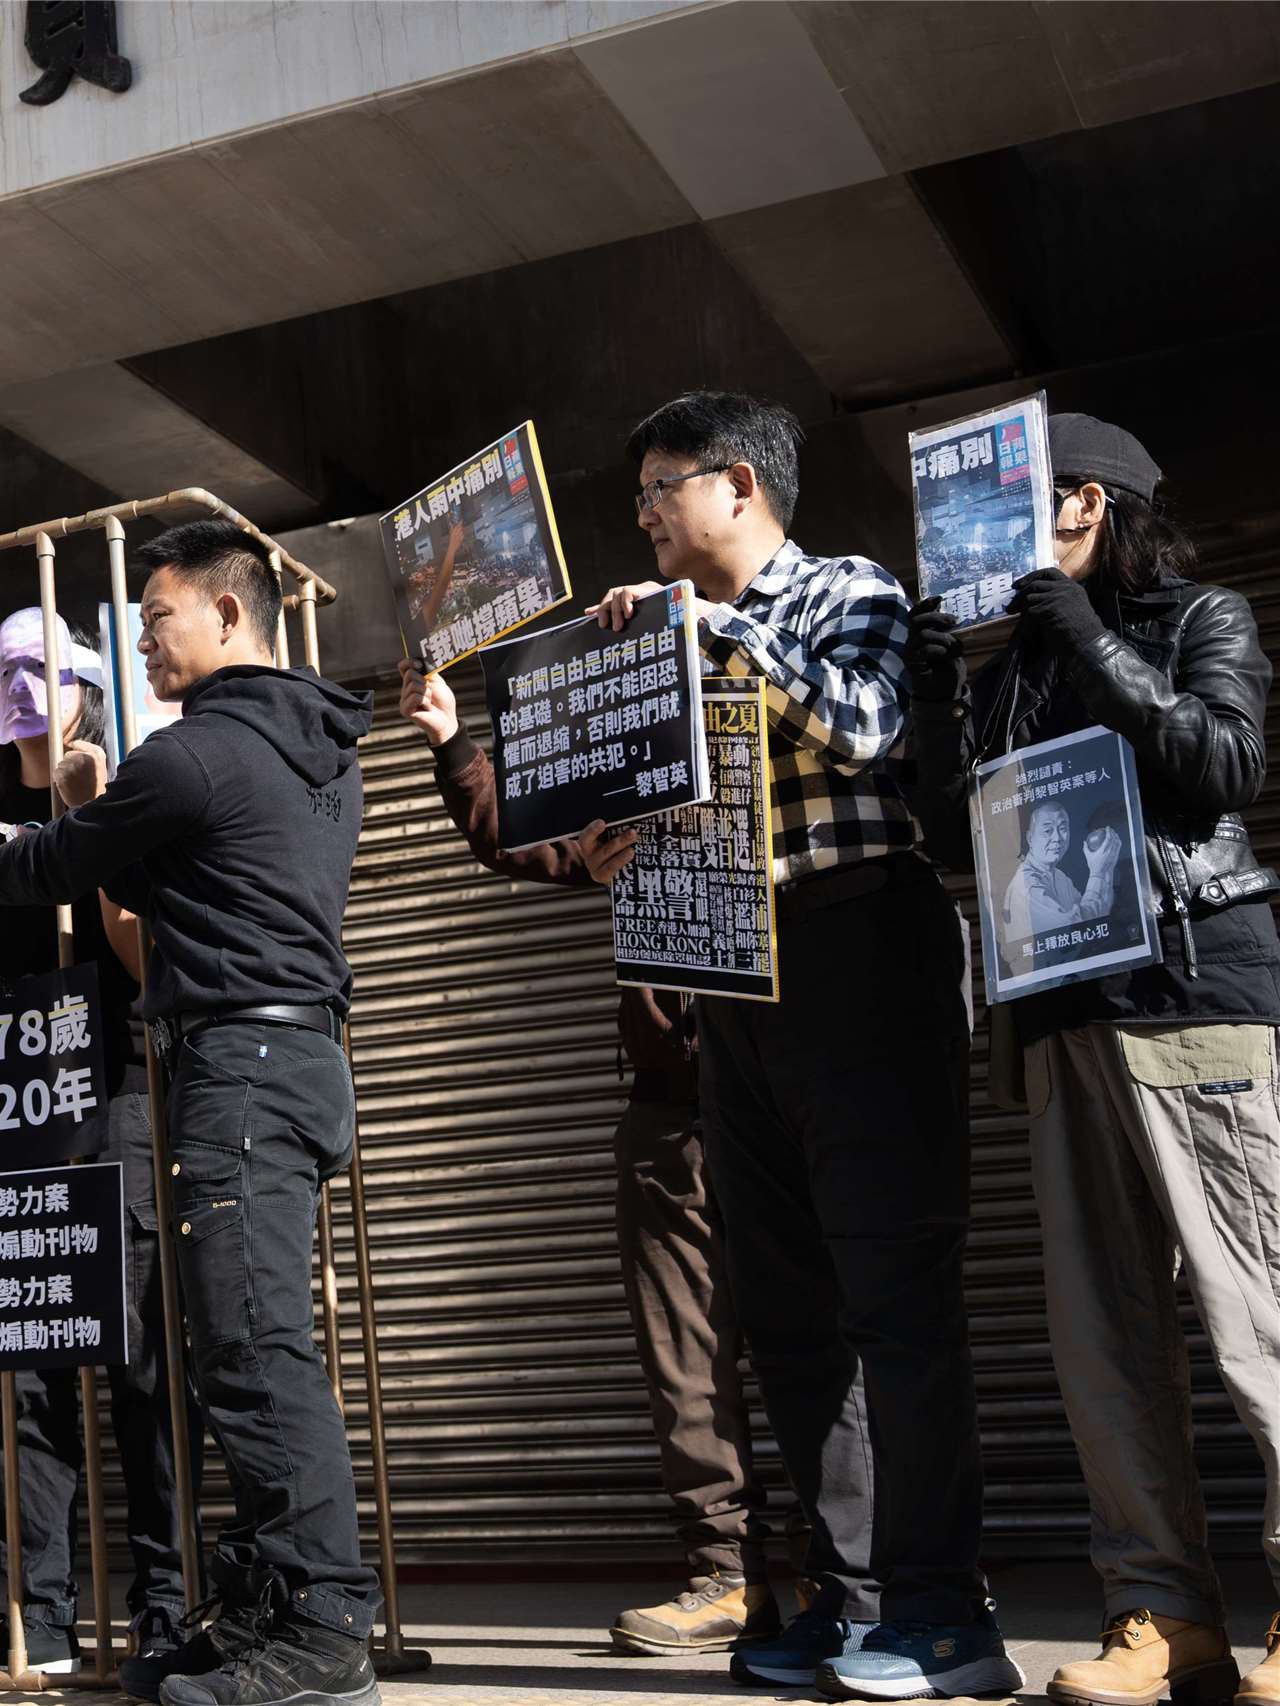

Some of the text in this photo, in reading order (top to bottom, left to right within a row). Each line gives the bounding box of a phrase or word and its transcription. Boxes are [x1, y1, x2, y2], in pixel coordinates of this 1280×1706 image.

[394, 448, 504, 541] 港人雨中痛別
[940, 572, 1017, 625] 蘋果
[507, 626, 676, 700] 「新聞自由是所有自由
[500, 658, 679, 737] 的基礎。我們不能因恐
[503, 690, 680, 769] 懼而退縮，否則我們就
[505, 740, 651, 800] 成了迫害的共犯。」
[615, 918, 656, 933] FREE
[616, 932, 710, 955] HONG KONG
